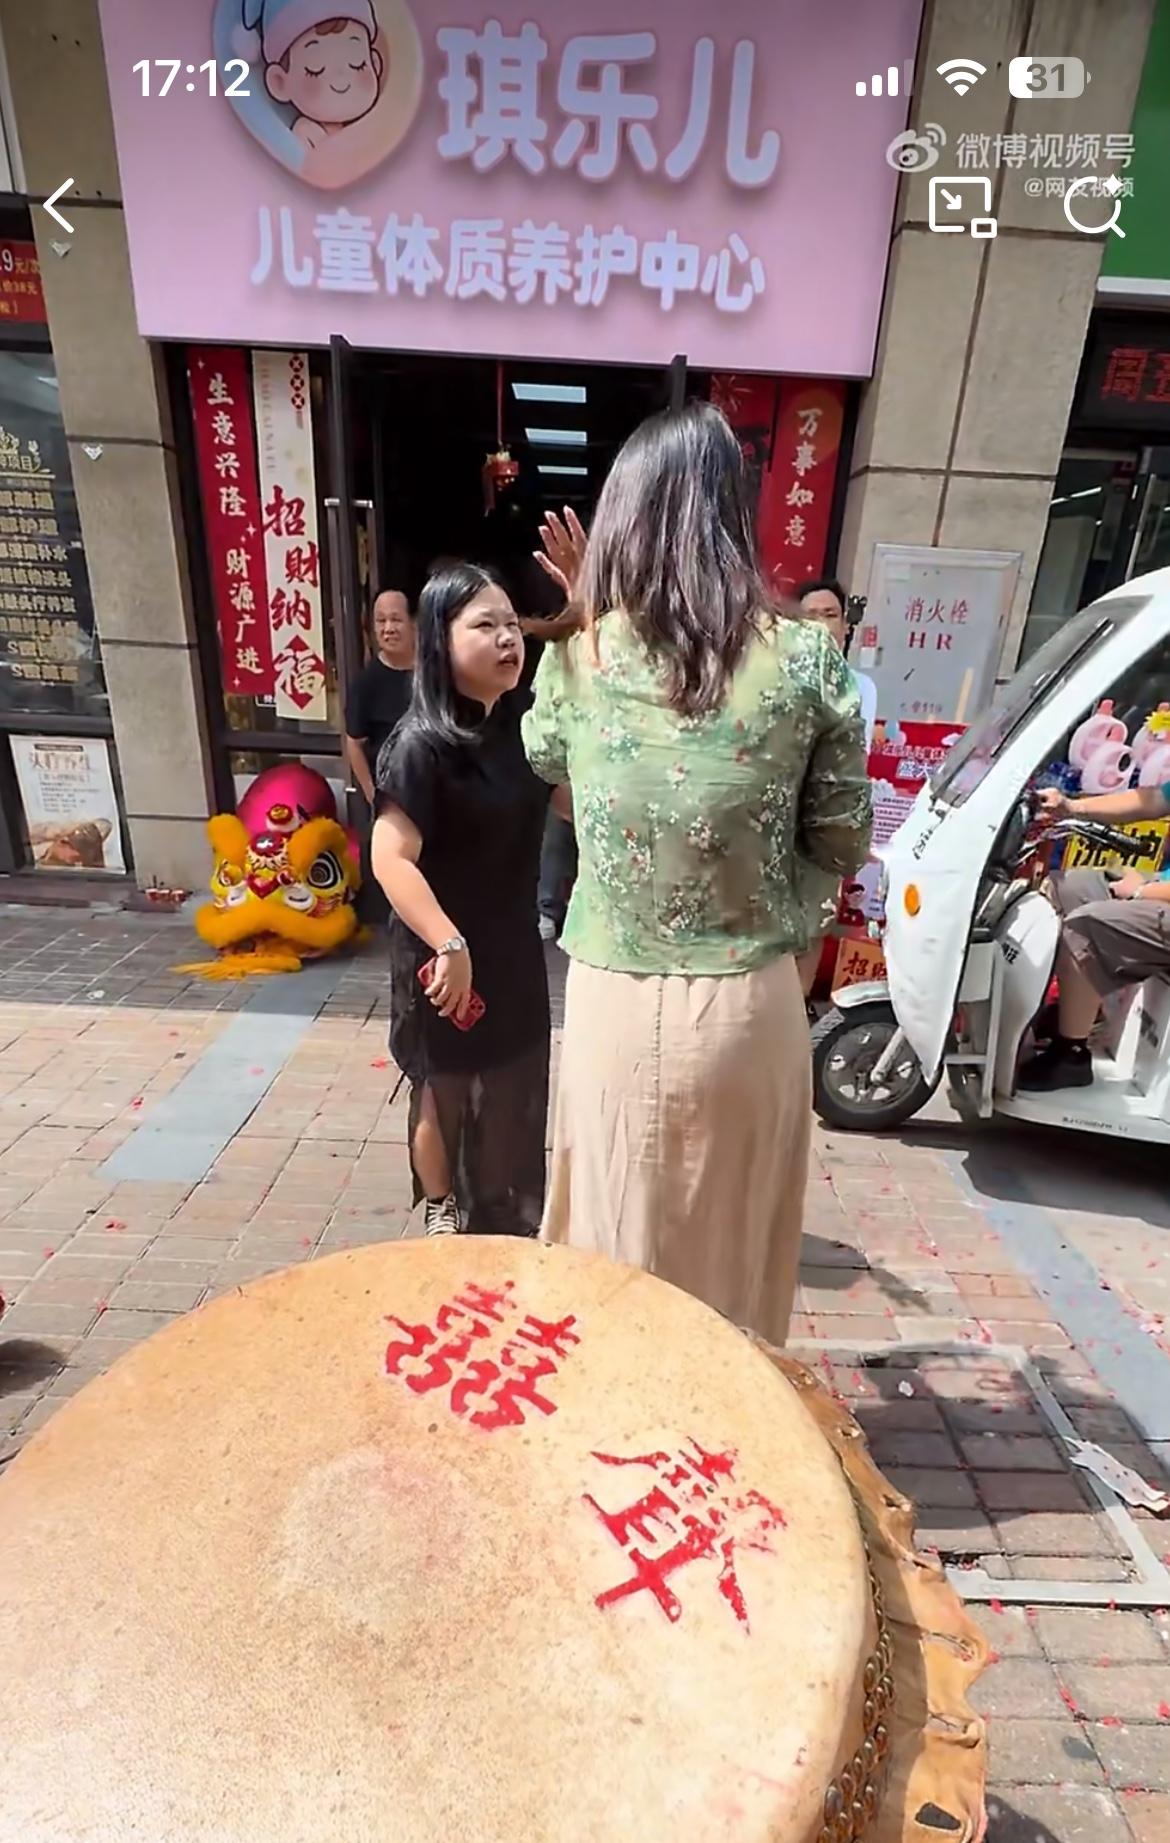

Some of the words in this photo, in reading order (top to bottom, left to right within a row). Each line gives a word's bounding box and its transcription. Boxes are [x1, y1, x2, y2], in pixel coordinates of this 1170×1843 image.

[436, 19, 780, 188] 琪乐儿
[251, 206, 765, 312] 儿童体质养护中心
[206, 372, 247, 518] 生意兴隆
[784, 407, 823, 548] 万事如意
[226, 548, 264, 675] 财源广进
[263, 485, 326, 697] 招財纳福
[904, 597, 969, 625] 消火栓
